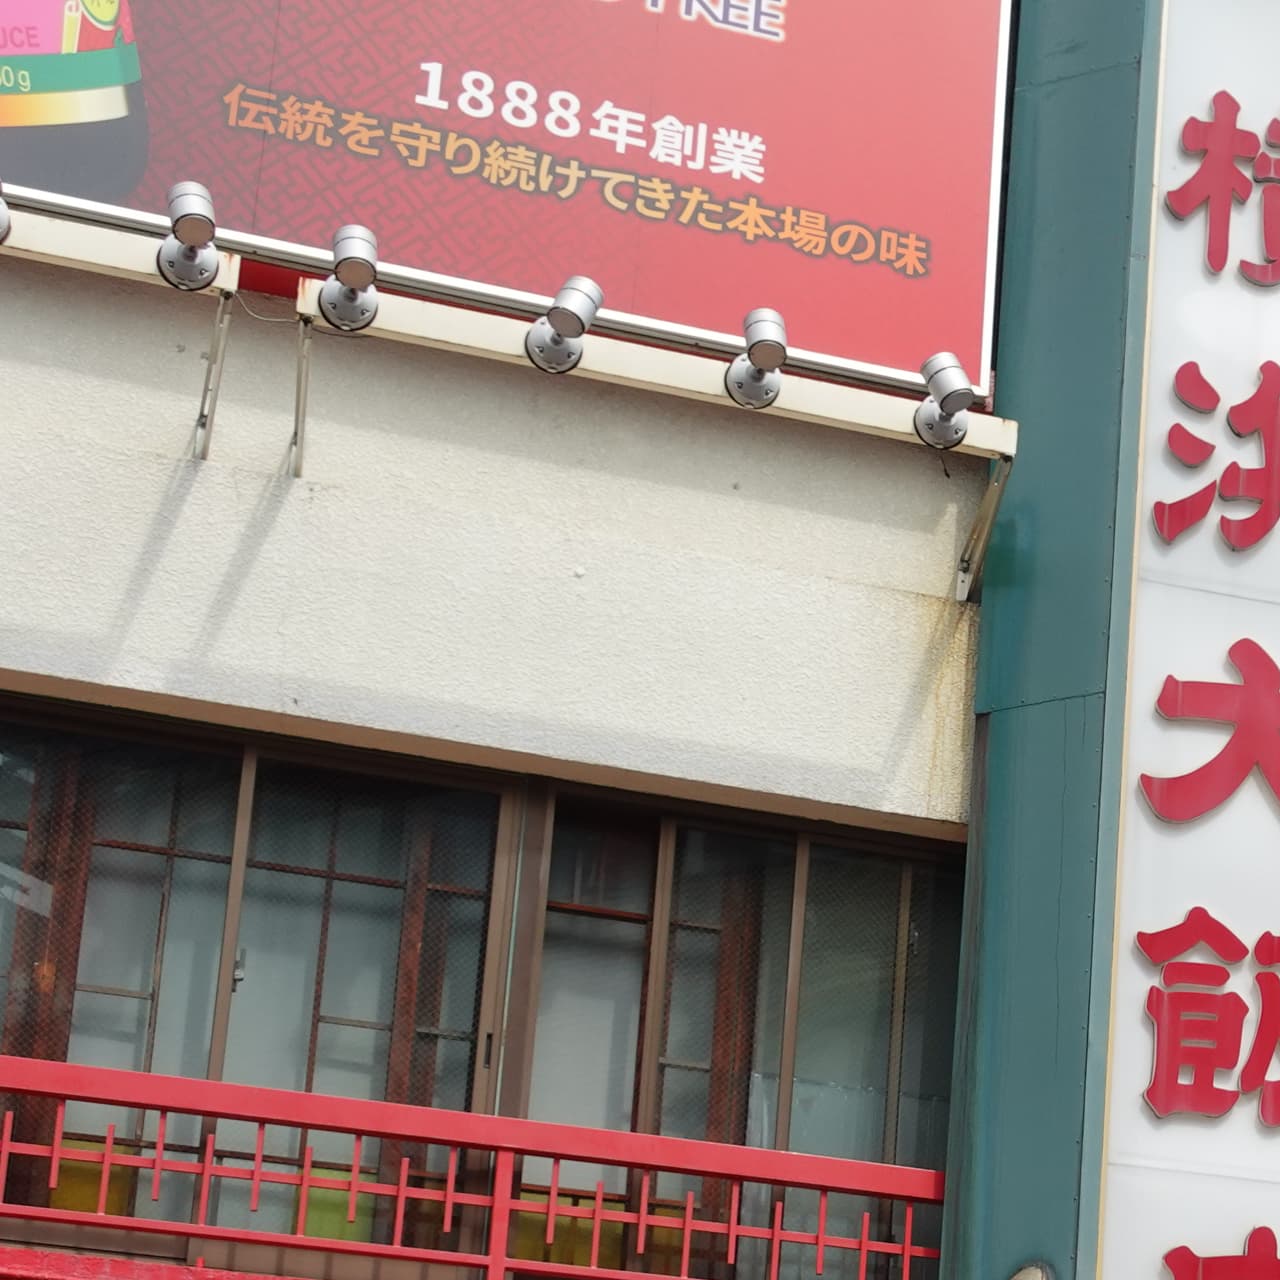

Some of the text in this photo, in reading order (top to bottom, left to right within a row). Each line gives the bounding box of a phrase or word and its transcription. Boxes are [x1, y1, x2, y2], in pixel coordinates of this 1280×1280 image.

[644, 0, 784, 41] EE
[222, 82, 932, 278] 伝統を守り続けてきた本場の味
[414, 61, 769, 183] 1888年創業
